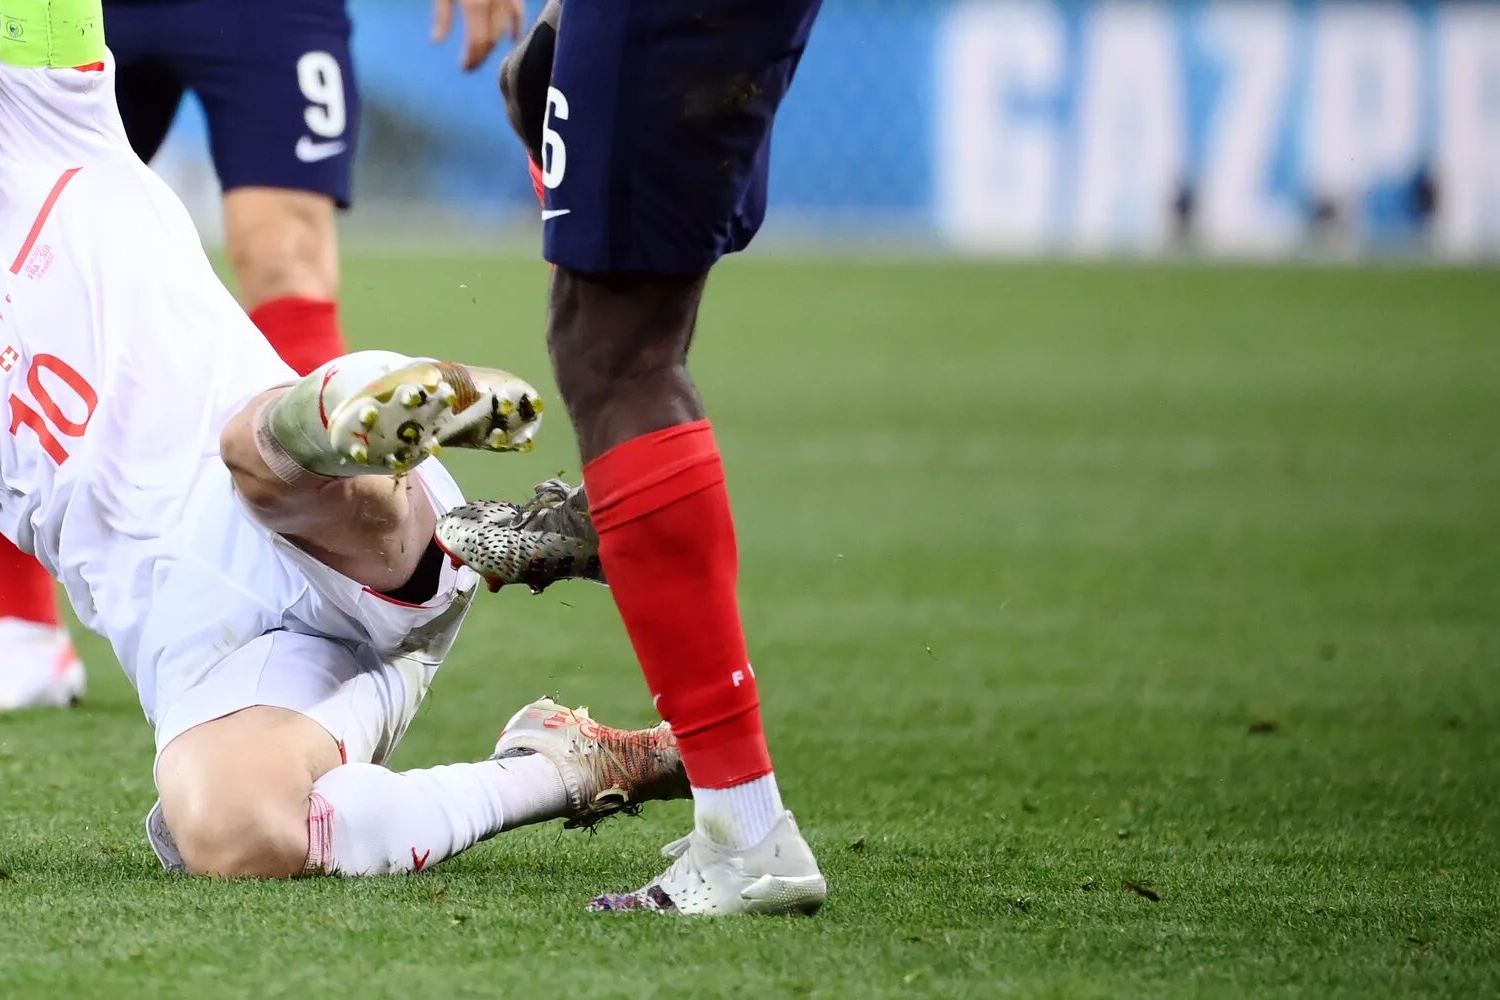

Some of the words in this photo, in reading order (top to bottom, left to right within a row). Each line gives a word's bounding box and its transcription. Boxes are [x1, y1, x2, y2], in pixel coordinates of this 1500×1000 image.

[297, 51, 347, 139] 9
[541, 86, 570, 190] 6
[8, 353, 98, 466] 10
